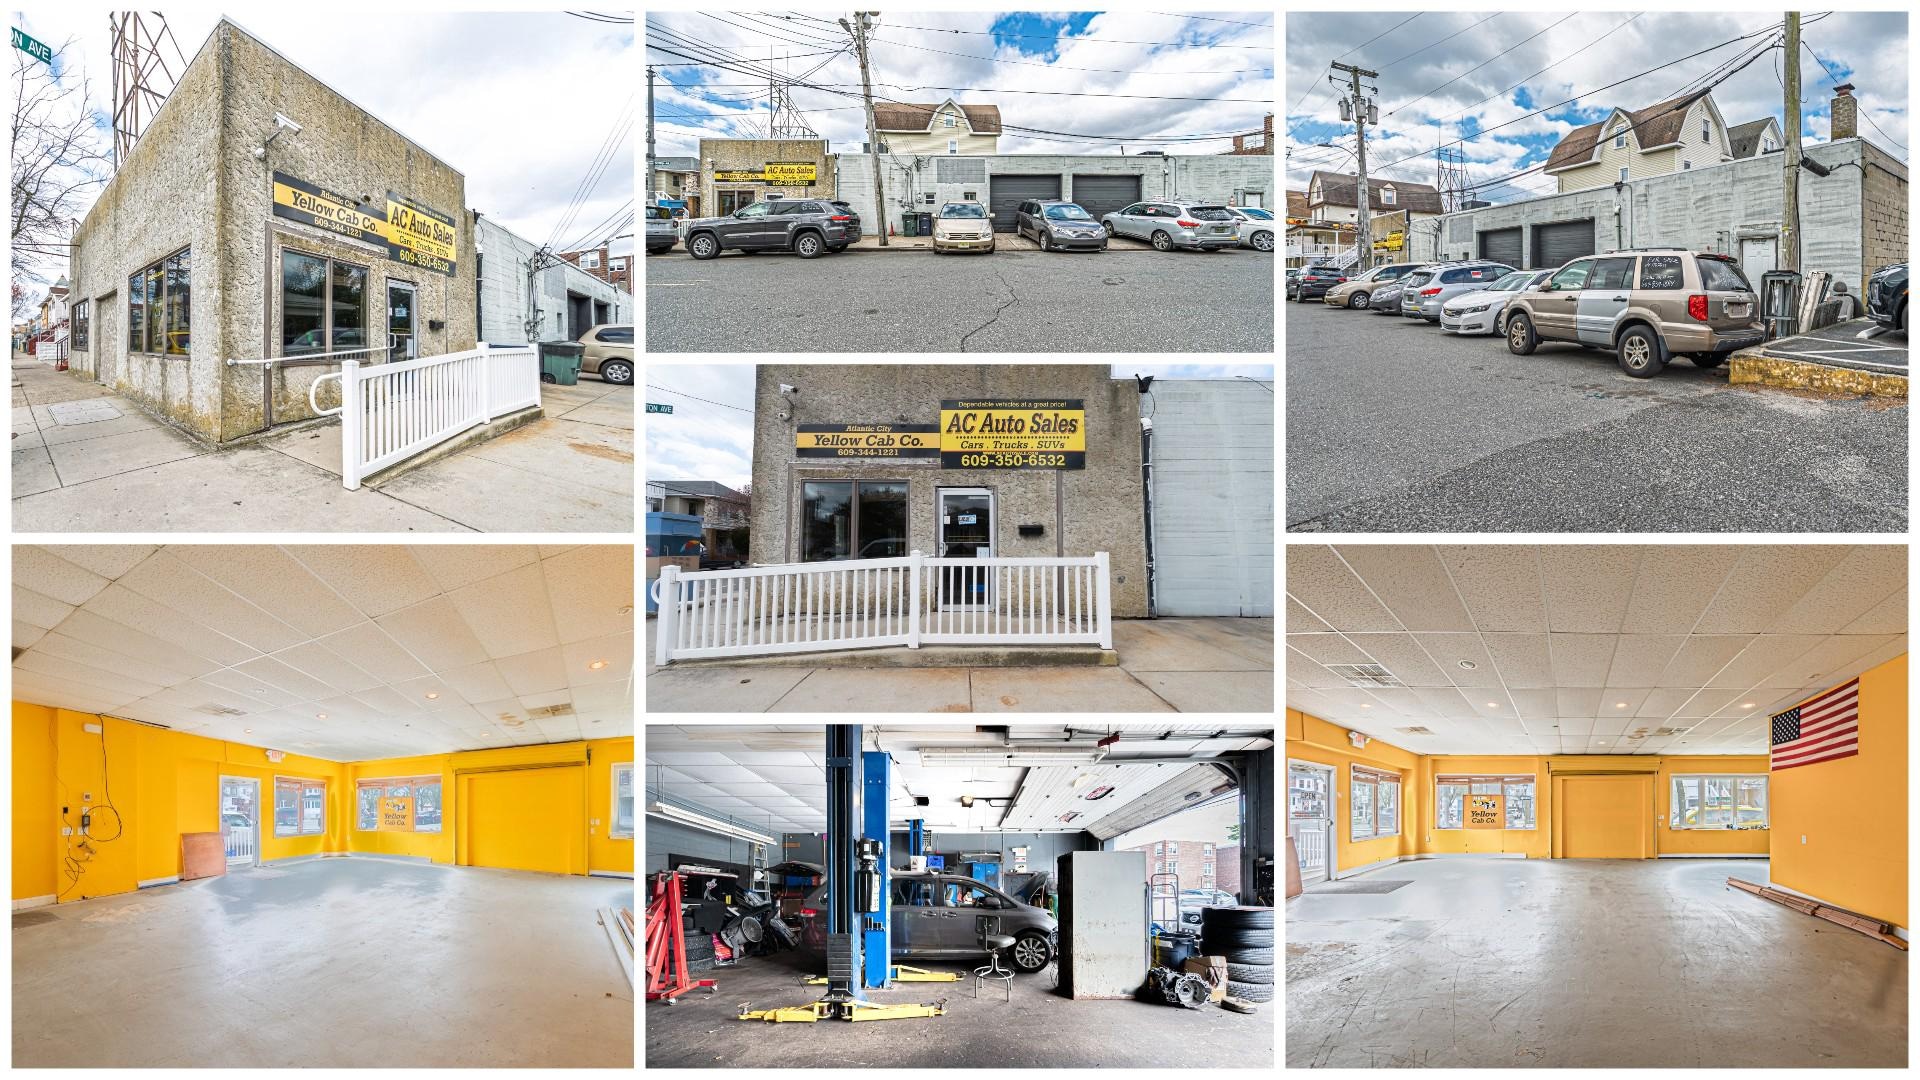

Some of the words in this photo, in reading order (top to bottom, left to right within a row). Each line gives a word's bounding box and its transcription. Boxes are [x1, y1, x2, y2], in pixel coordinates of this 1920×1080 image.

[29, 40, 50, 60] AVE
[768, 166, 779, 175] AC
[779, 166, 796, 175] Auto
[797, 166, 814, 175] Sales
[320, 190, 343, 204] Atlantic
[292, 190, 335, 218] Yellow
[337, 207, 359, 226] Cab
[362, 216, 379, 233] Co.
[314, 216, 363, 239] 609-344-1221
[390, 205, 408, 229] AC
[409, 213, 432, 238] Auto
[433, 222, 454, 247] Sales
[399, 235, 412, 246] Cars
[400, 249, 450, 273] 609-350-6532
[958, 401, 994, 409] Dependable
[1033, 401, 1049, 409] great
[876, 425, 893, 433] City
[946, 412, 978, 434] AC
[978, 412, 1026, 434] Auto
[1029, 412, 1079, 434] Sales
[814, 434, 862, 447] Yellow
[865, 434, 895, 447] Cab
[899, 434, 924, 447] Co.
[960, 440, 984, 449] Cars
[993, 440, 1029, 449] Trucks
[1036, 440, 1065, 449] SUVs
[837, 448, 899, 456] 609-344-1221
[961, 454, 1066, 467] 609-350-6532
